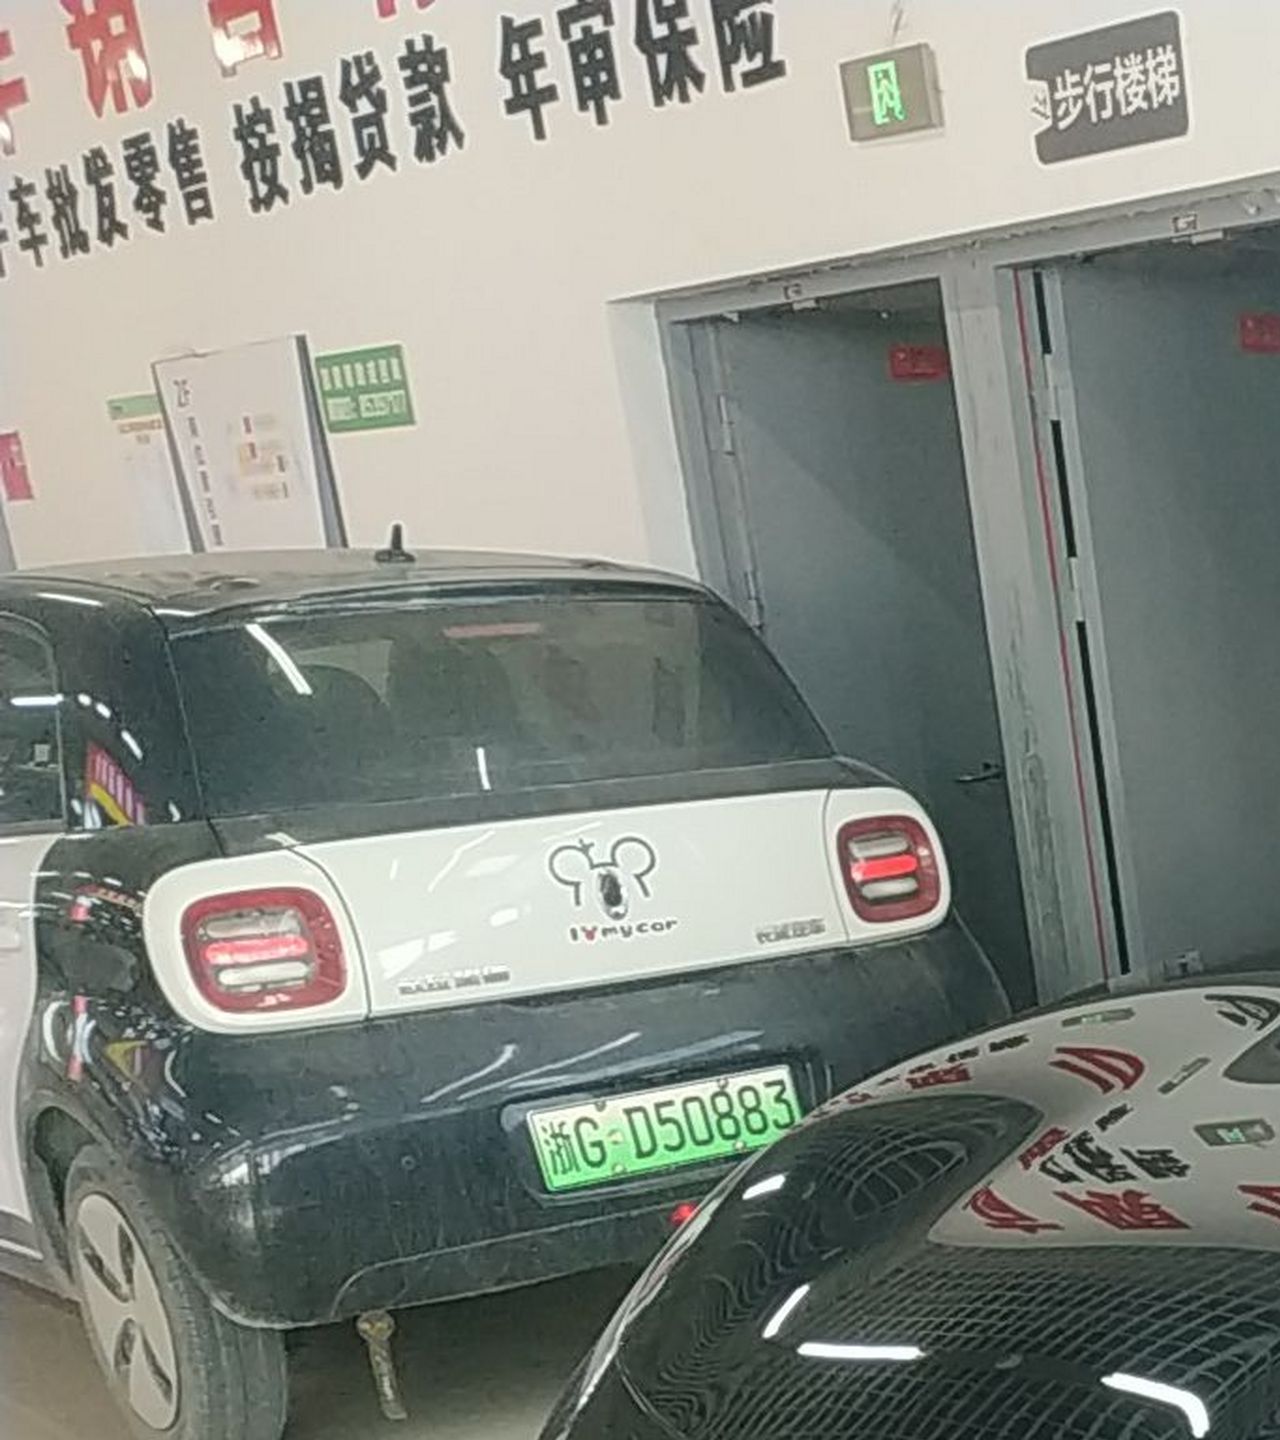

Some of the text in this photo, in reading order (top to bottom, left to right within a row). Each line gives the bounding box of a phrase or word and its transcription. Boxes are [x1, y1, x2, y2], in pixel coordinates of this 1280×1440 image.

[0, 117, 214, 278] 车批发零售
[232, 33, 465, 214] 按揭贷款
[497, 0, 788, 141] 年审保险
[1053, 44, 1182, 131] 步行楼梯
